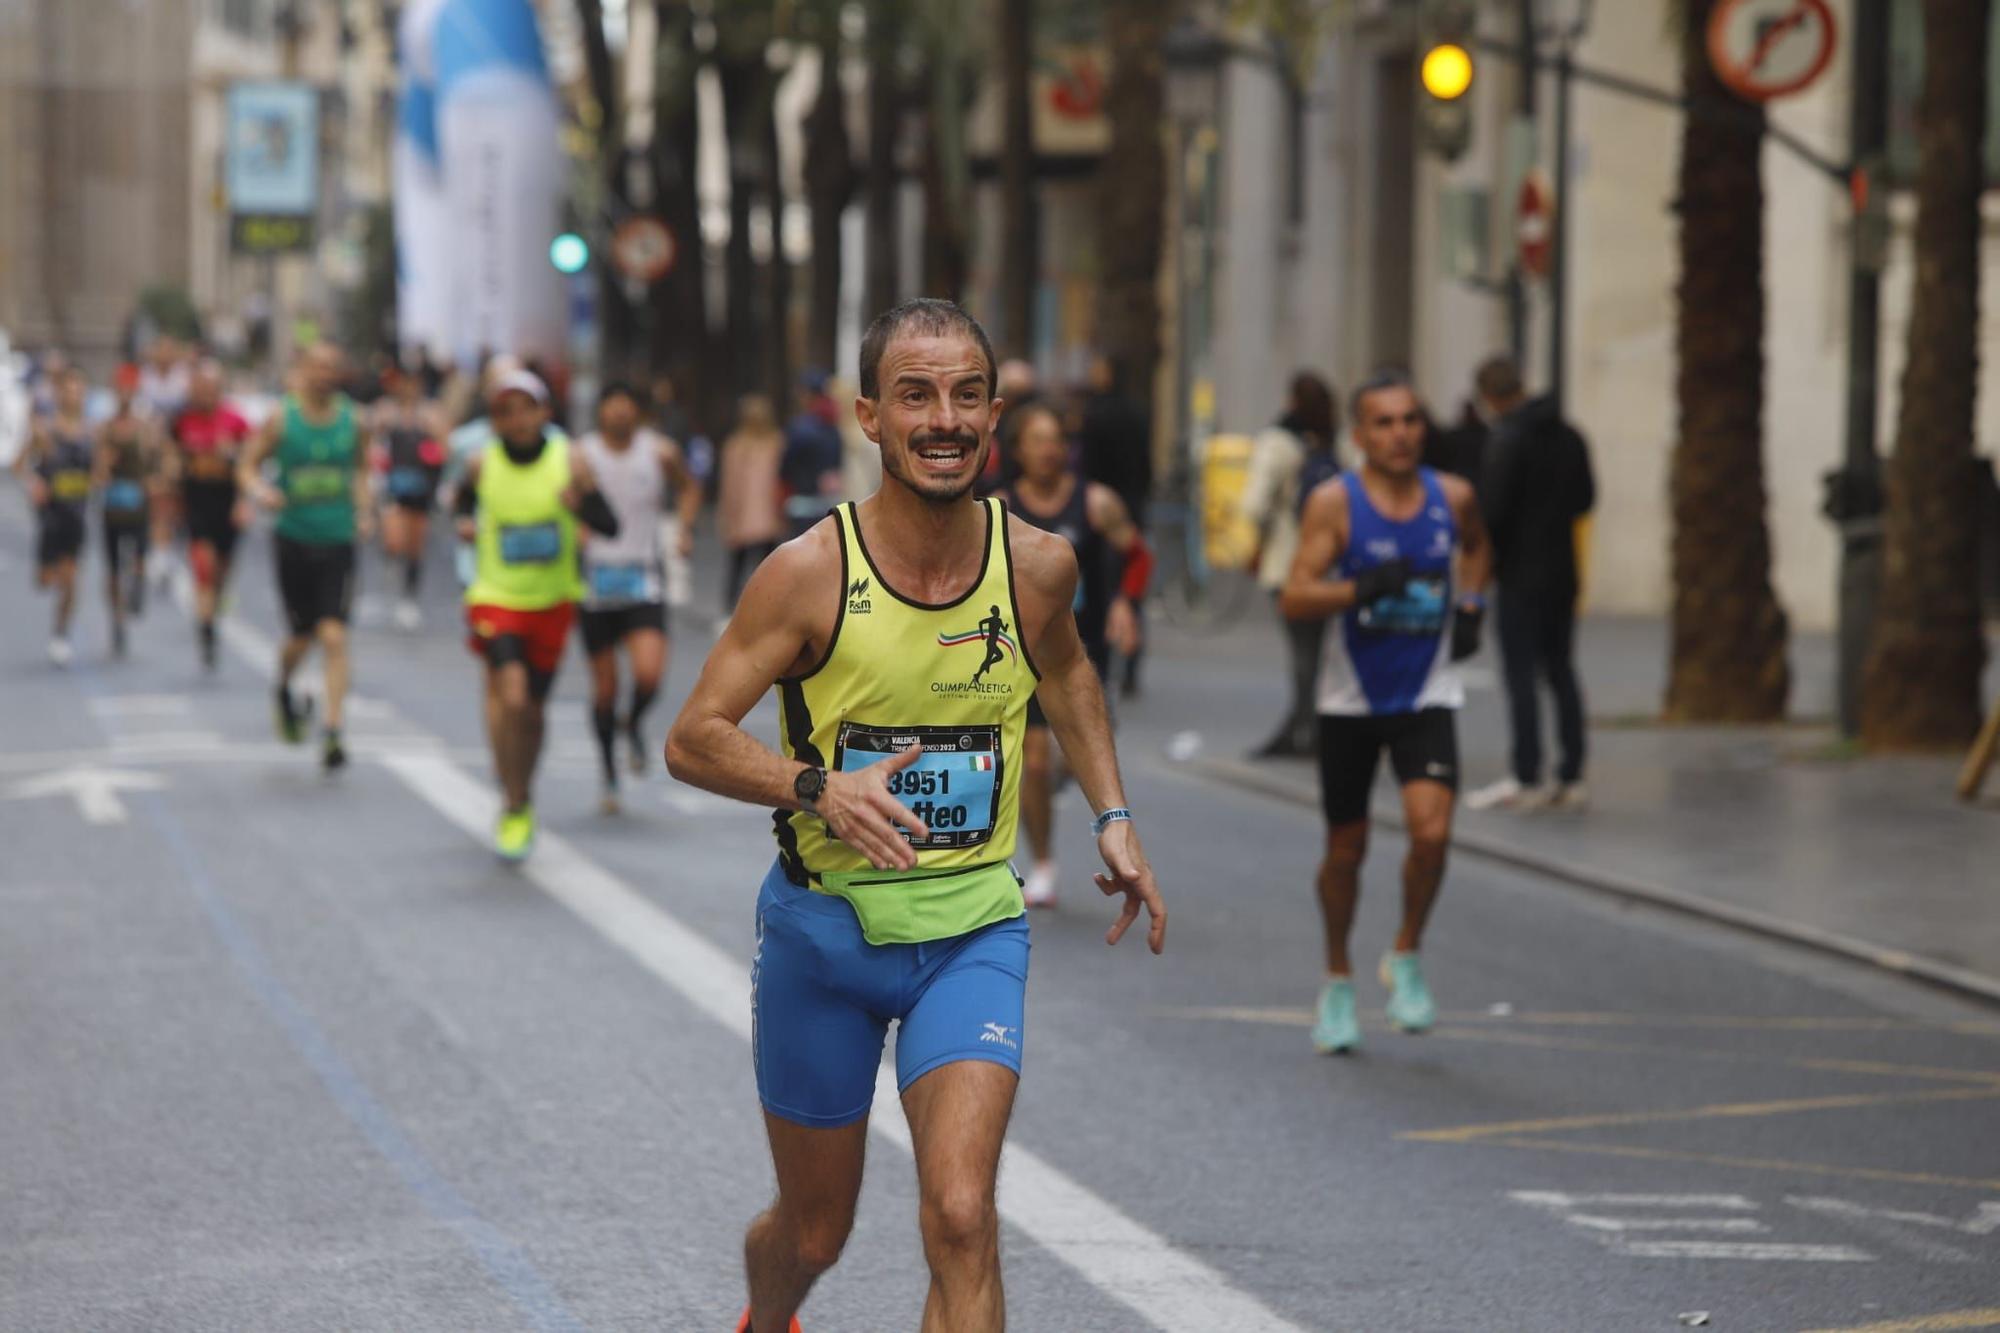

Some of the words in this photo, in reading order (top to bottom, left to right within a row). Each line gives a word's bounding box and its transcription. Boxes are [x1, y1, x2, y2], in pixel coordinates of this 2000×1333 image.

[891, 736, 921, 744] VALENCIA
[940, 744, 956, 752] 2022
[887, 769, 949, 795] 3951
[891, 801, 967, 828] tteo
